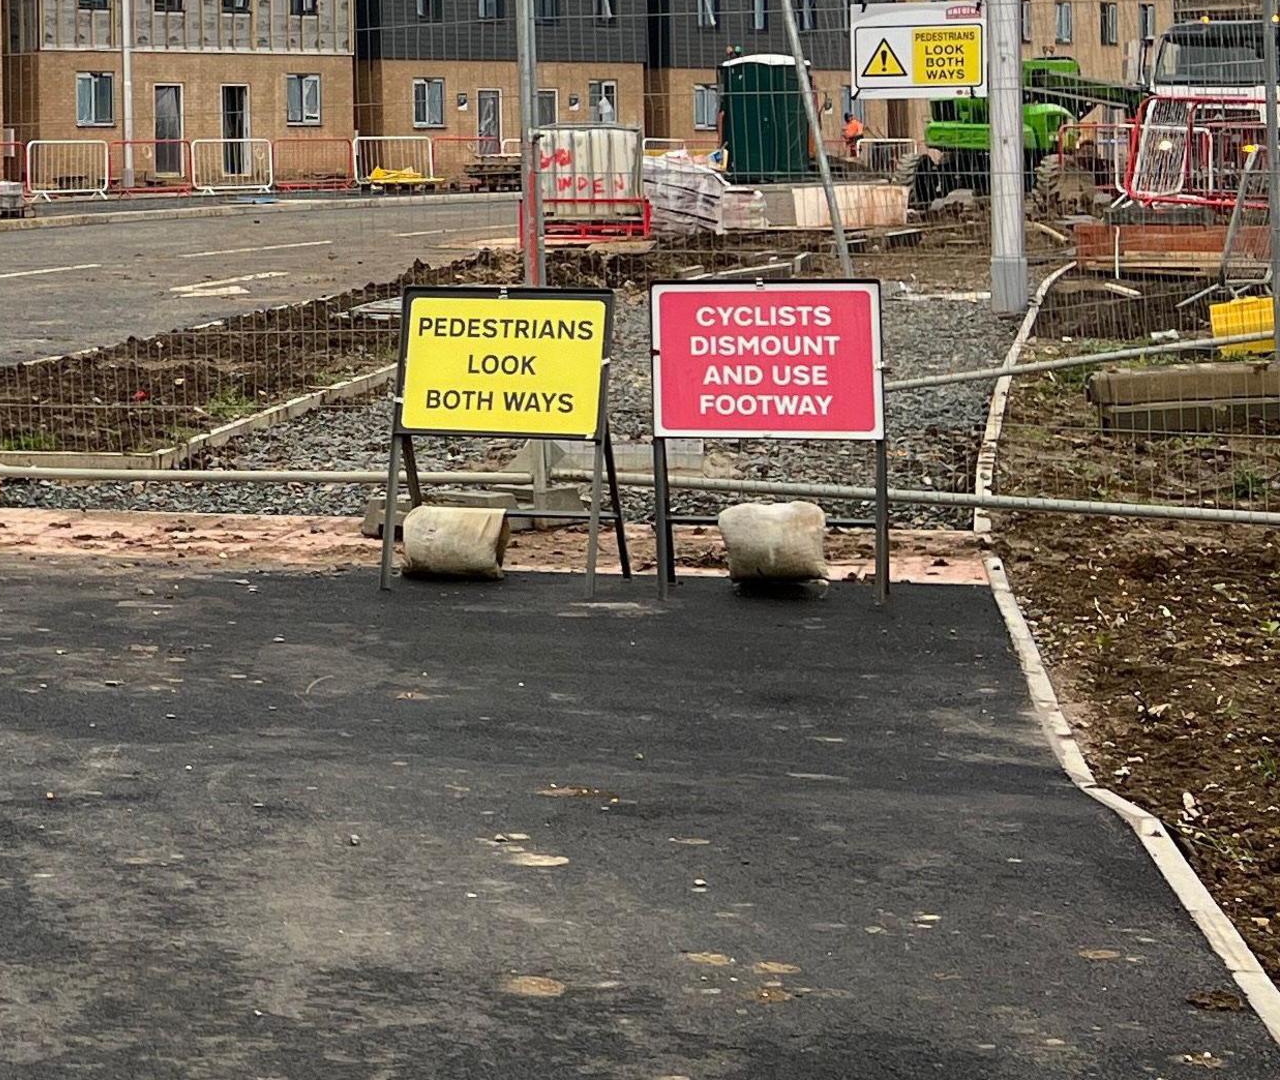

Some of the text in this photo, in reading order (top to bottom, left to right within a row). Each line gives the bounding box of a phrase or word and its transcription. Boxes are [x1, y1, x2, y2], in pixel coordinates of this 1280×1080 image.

[915, 31, 975, 42] PEDESTRIANS
[925, 45, 964, 55] LOOK
[926, 57, 964, 68] BOTH
[926, 69, 965, 80] WAYS
[696, 305, 832, 327] CYCLISTS
[418, 317, 594, 340] PEDESTRIANS
[690, 335, 841, 356] DISMOUNT
[468, 354, 536, 375] LOOK
[703, 364, 829, 386] AND USE
[426, 389, 573, 413] BOTH WAYS
[700, 394, 833, 415] FOOTWAY
